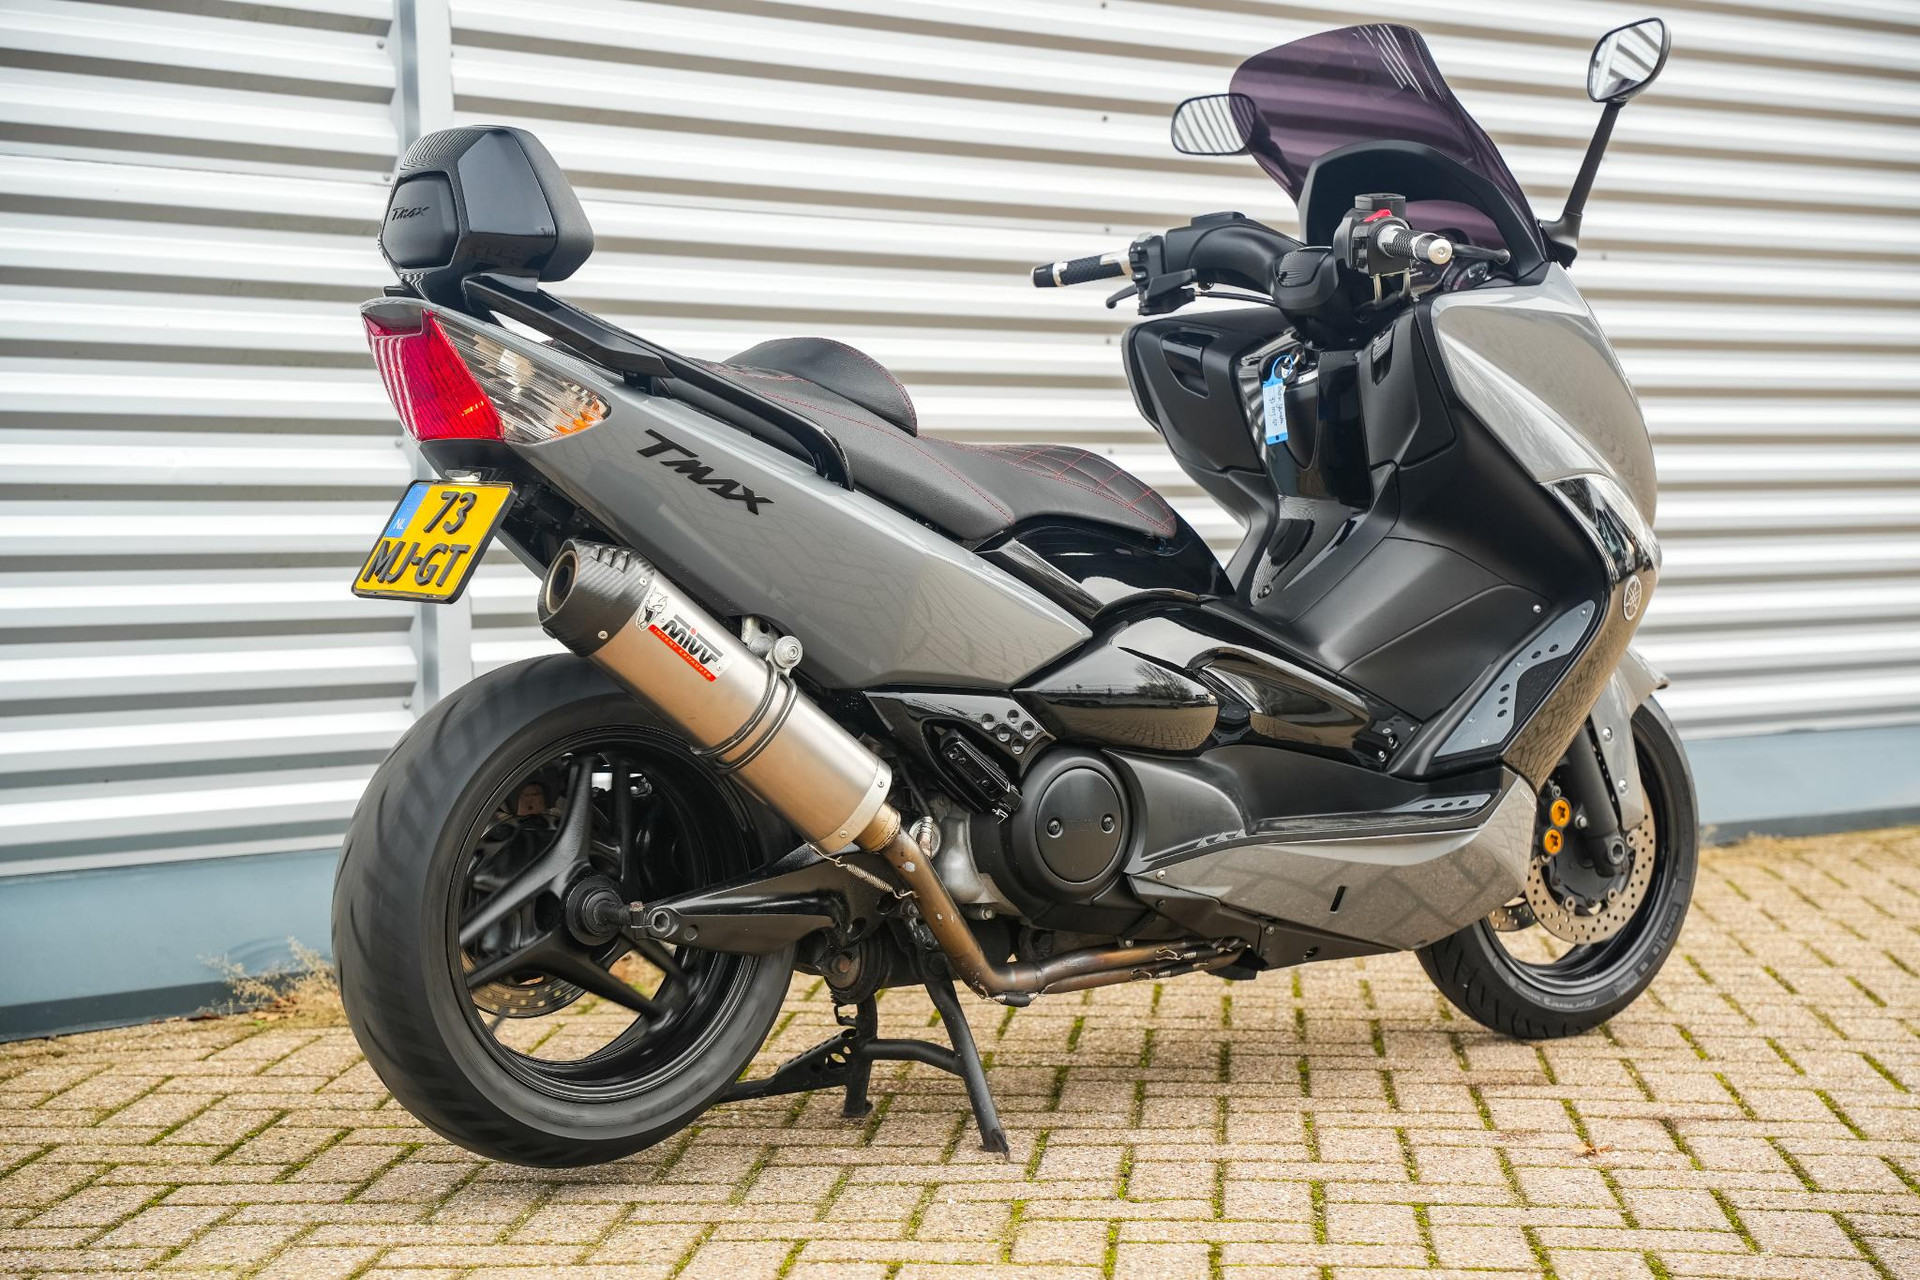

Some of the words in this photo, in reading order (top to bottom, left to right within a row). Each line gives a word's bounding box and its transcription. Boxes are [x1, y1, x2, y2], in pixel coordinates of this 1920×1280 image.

[637, 428, 774, 515] TMAX
[394, 518, 405, 530] NL
[423, 491, 477, 534] 73
[362, 541, 471, 587] MJ-GT
